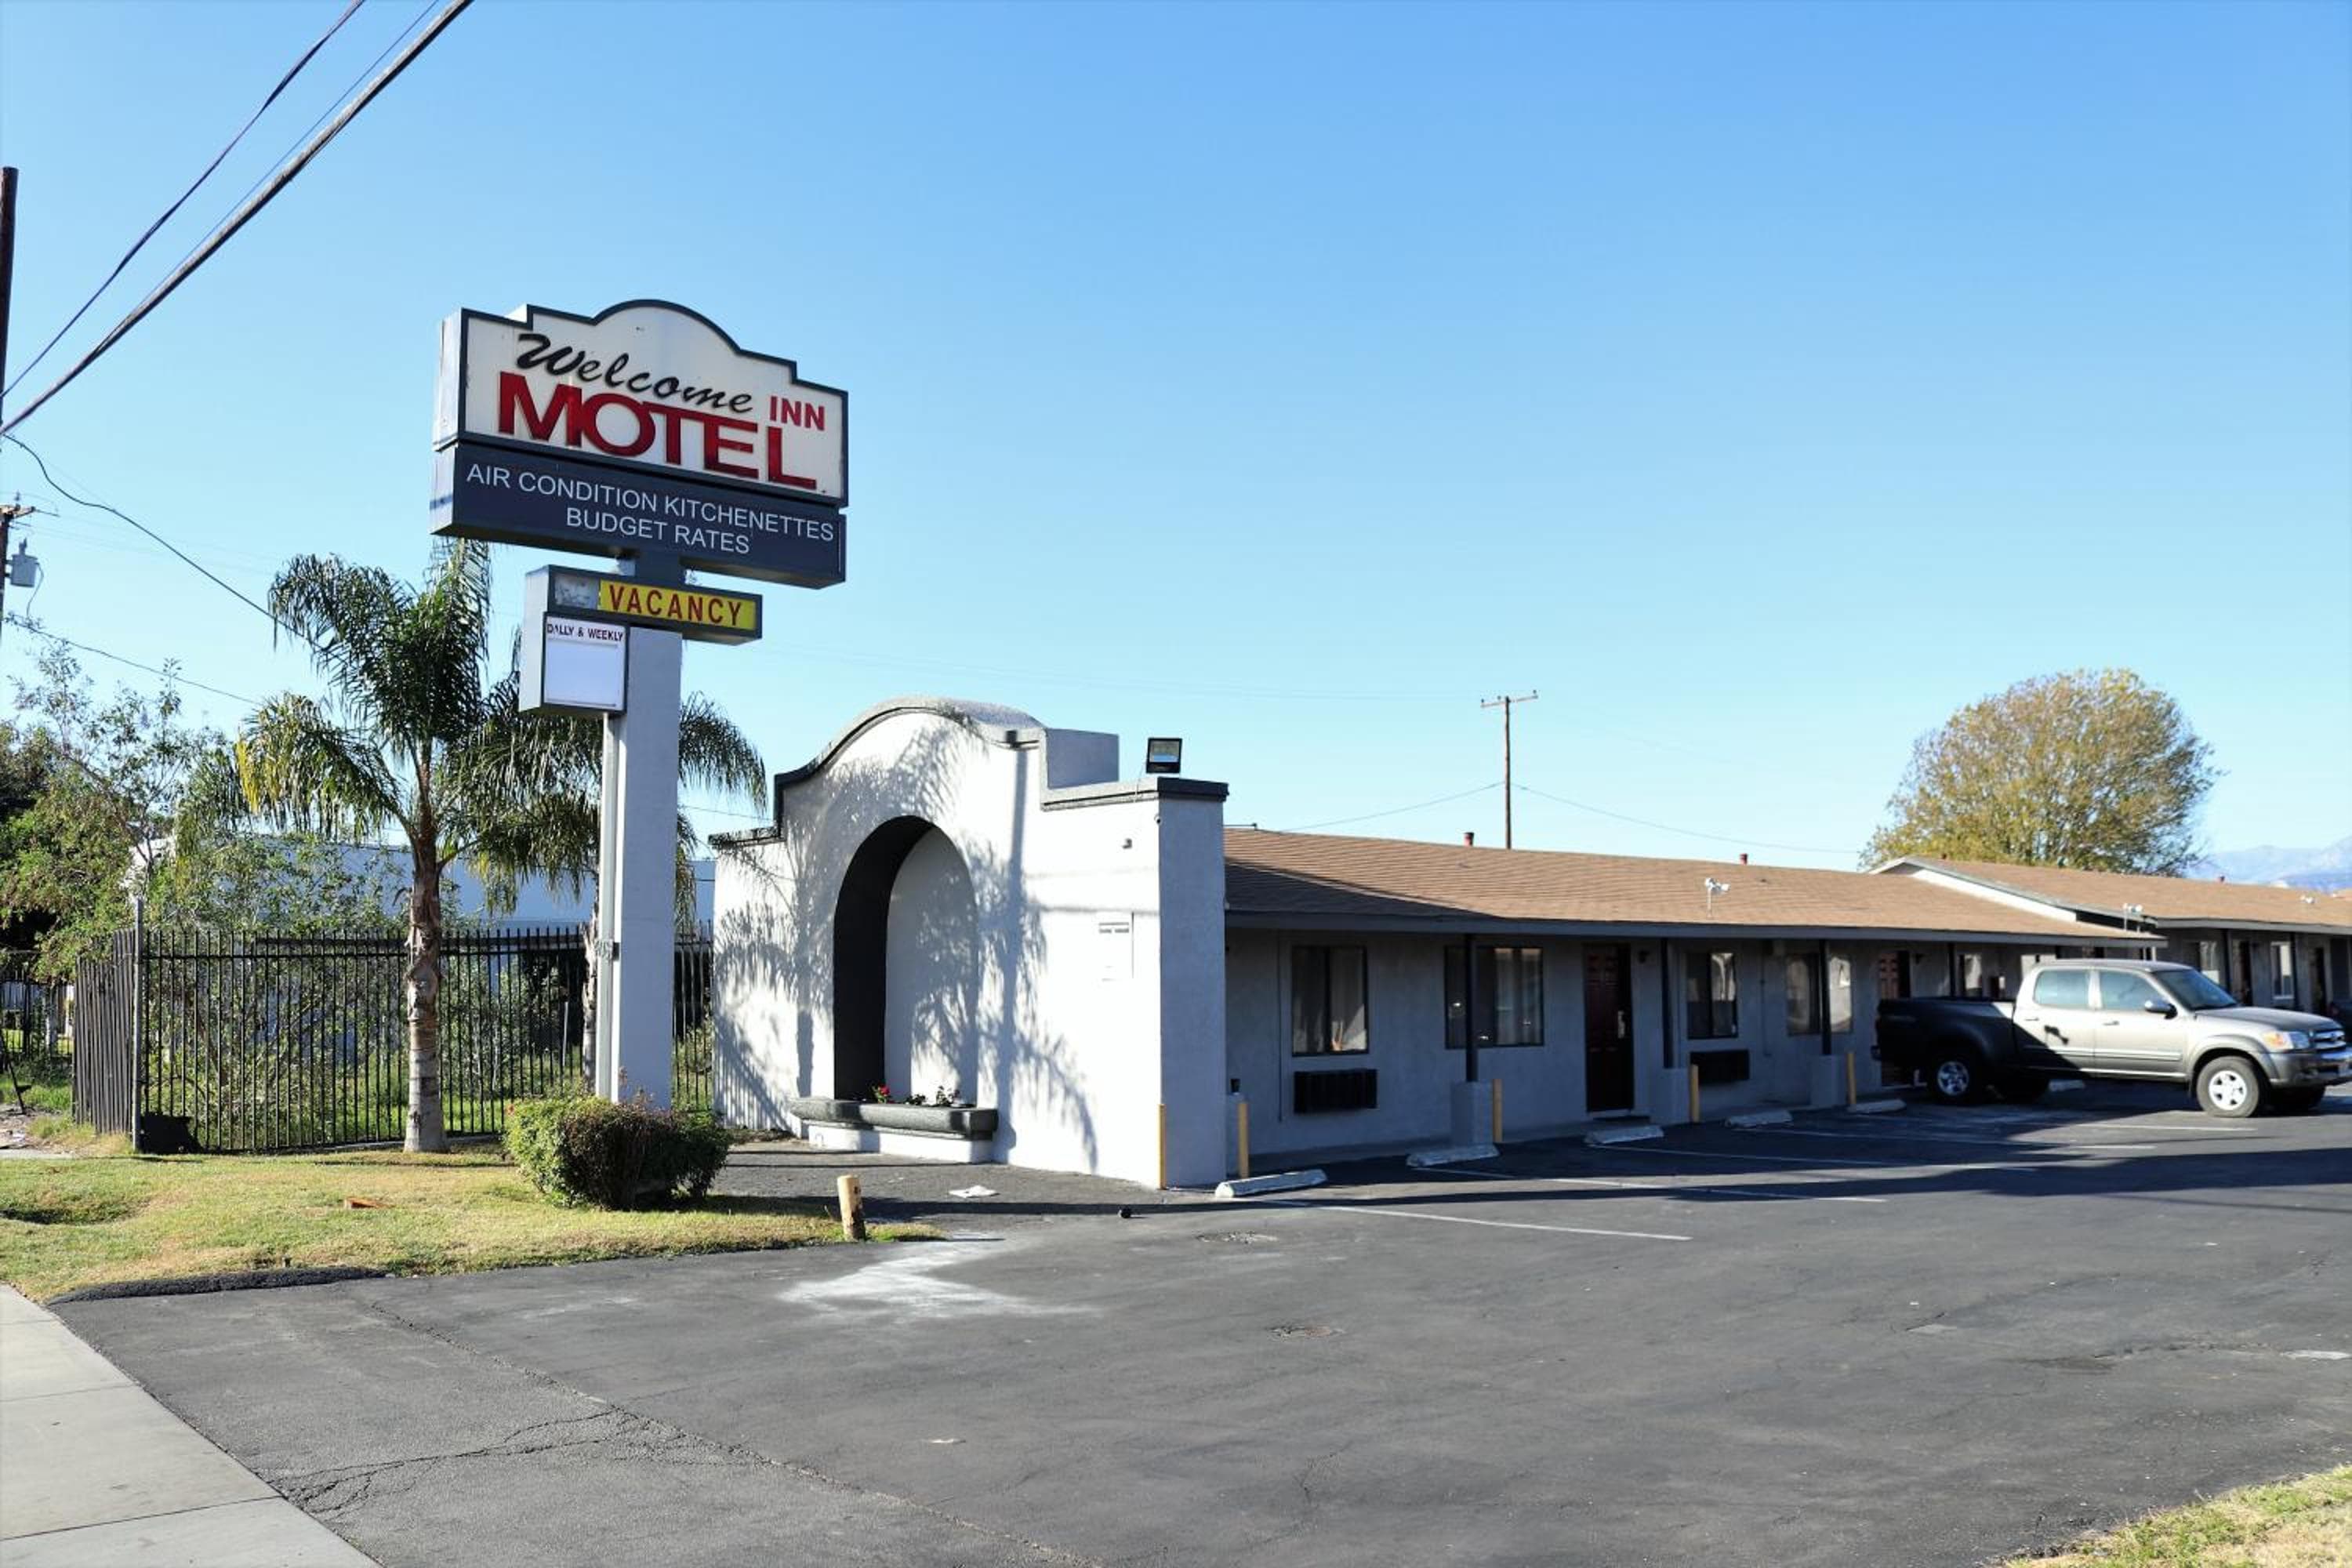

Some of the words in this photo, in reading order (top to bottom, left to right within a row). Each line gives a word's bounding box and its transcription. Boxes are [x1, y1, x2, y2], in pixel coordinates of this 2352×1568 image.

[517, 333, 753, 412] Welcome
[498, 371, 817, 491] MOTEL
[769, 395, 825, 431] INN
[466, 463, 510, 489] AIR
[518, 472, 657, 511] CONDITION
[664, 495, 834, 541] KITCHENETTES
[566, 506, 668, 540] BUDGET
[674, 524, 750, 554] RATES
[608, 584, 742, 626] VACANCY
[577, 626, 584, 637] &
[587, 627, 624, 641] WEEKLY
